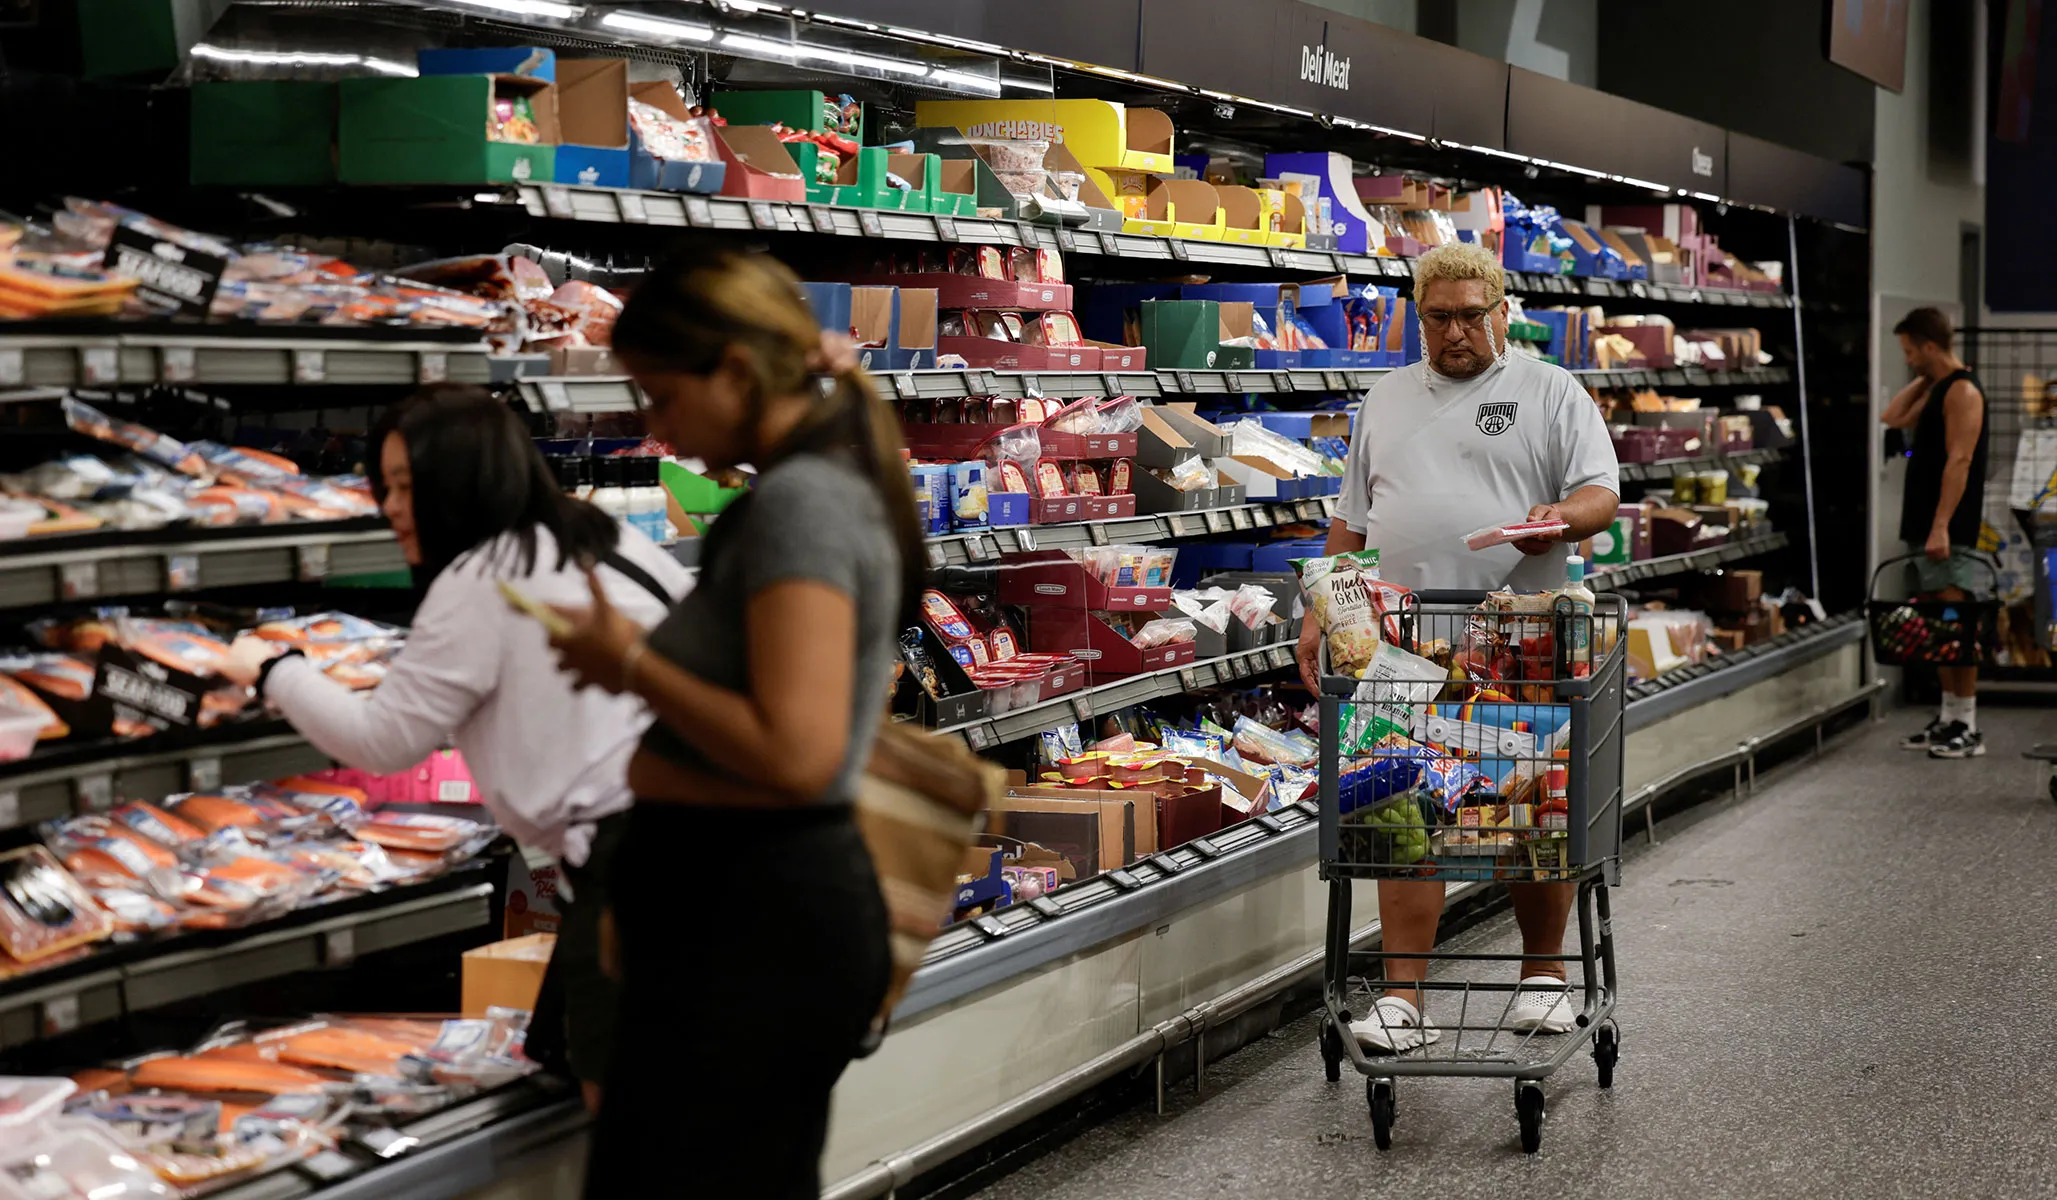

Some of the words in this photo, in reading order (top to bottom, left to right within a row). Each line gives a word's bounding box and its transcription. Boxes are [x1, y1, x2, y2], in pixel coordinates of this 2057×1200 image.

[1301, 44, 1324, 84] Deli
[1323, 51, 1351, 91] Meat
[1479, 404, 1515, 423] PUMA
[1306, 560, 1330, 571] Simply
[1340, 618, 1358, 628] FREE
